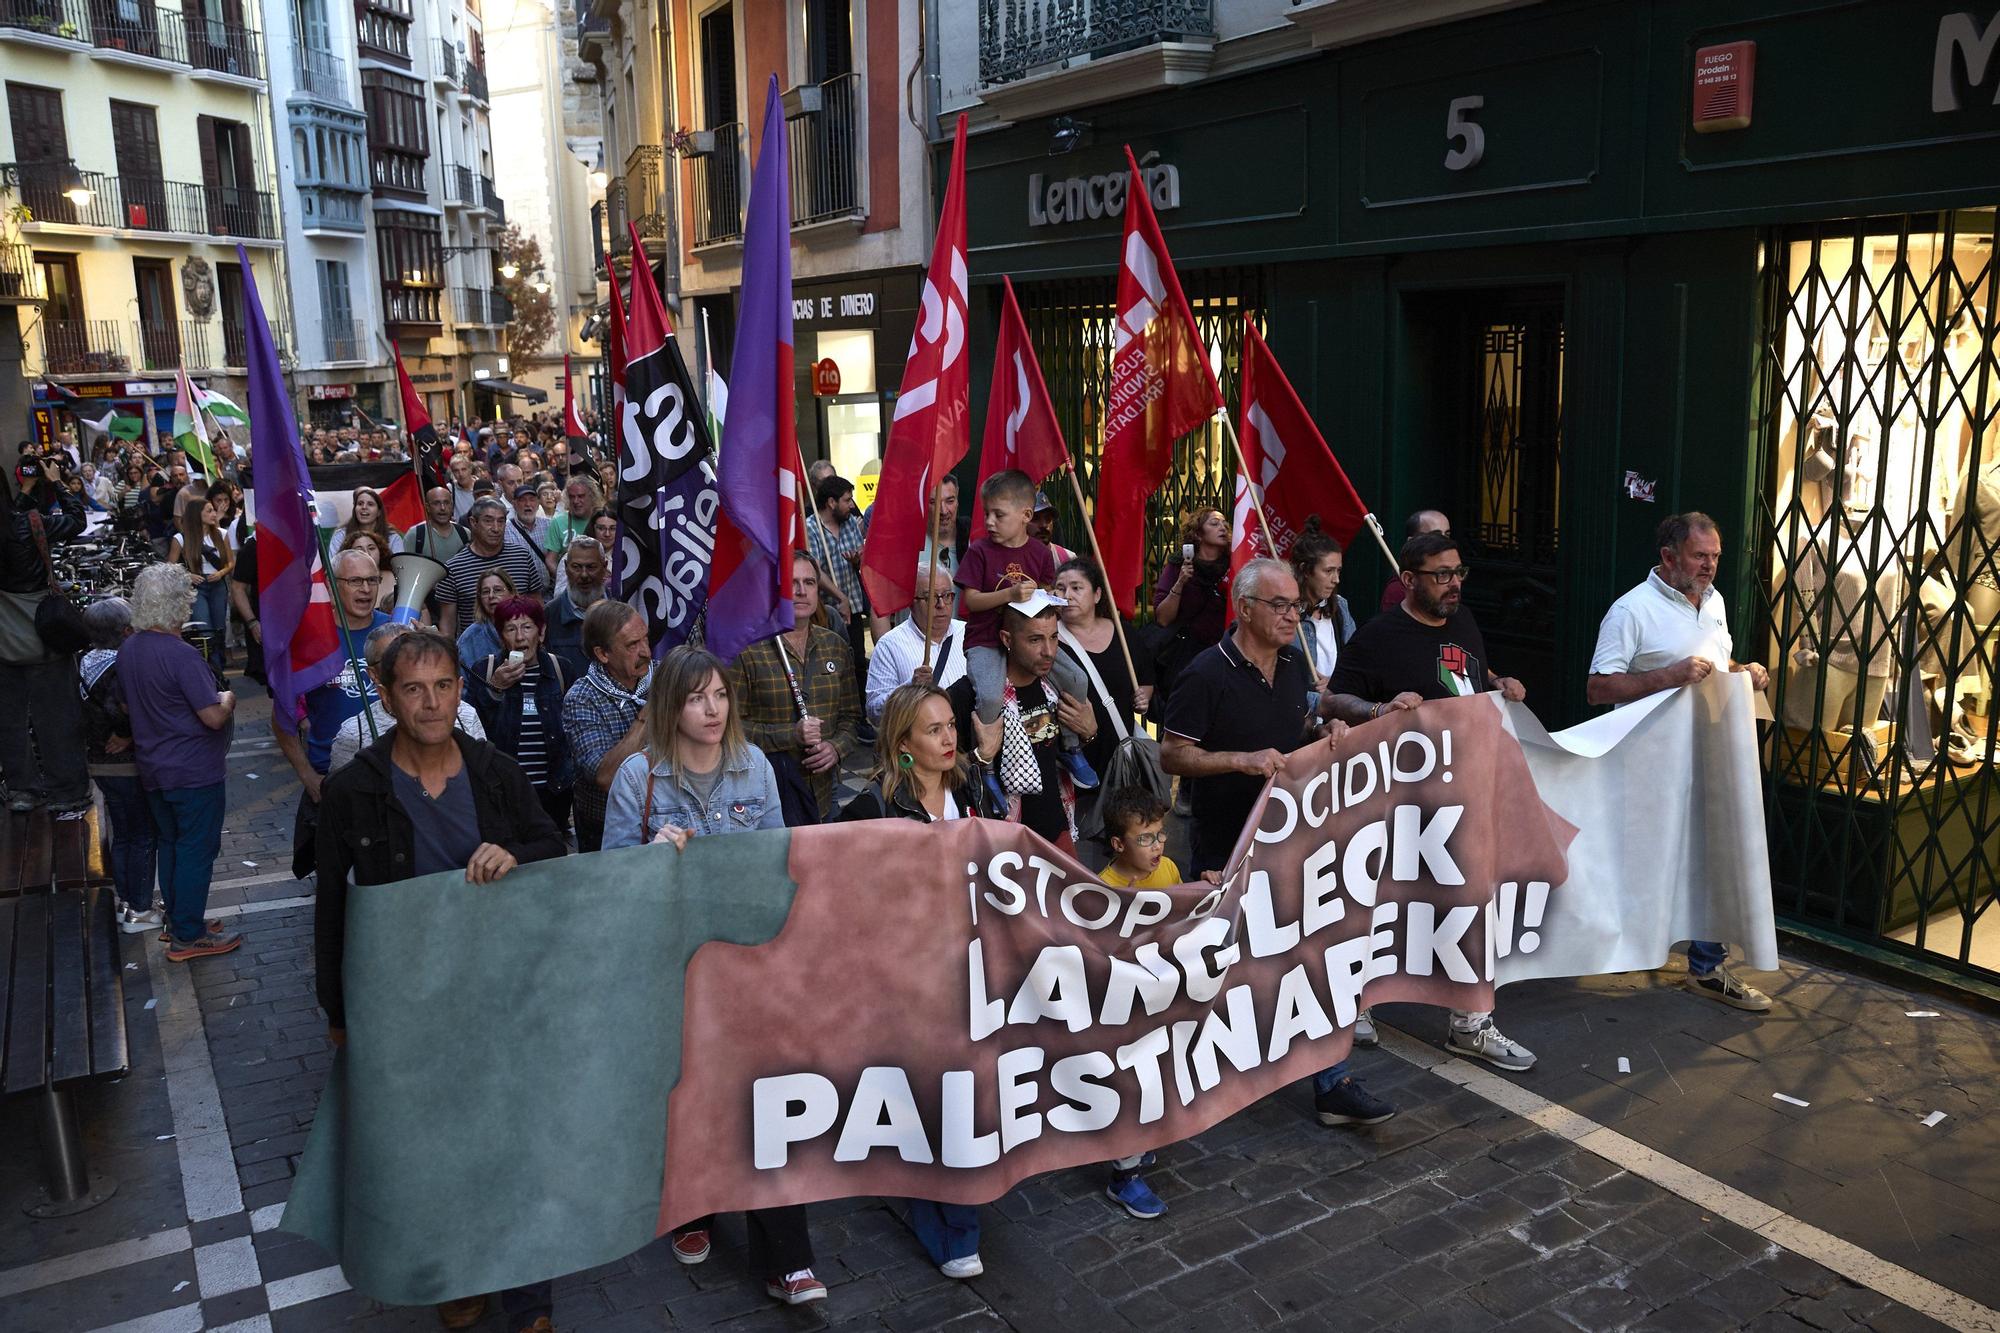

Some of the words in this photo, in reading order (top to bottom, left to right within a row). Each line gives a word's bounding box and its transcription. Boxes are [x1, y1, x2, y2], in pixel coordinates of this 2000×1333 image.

[1704, 53, 1733, 64] FUEGO
[1444, 95, 1485, 170] 5
[821, 297, 833, 318] DE
[840, 293, 874, 316] DINERO
[819, 363, 839, 384] ria
